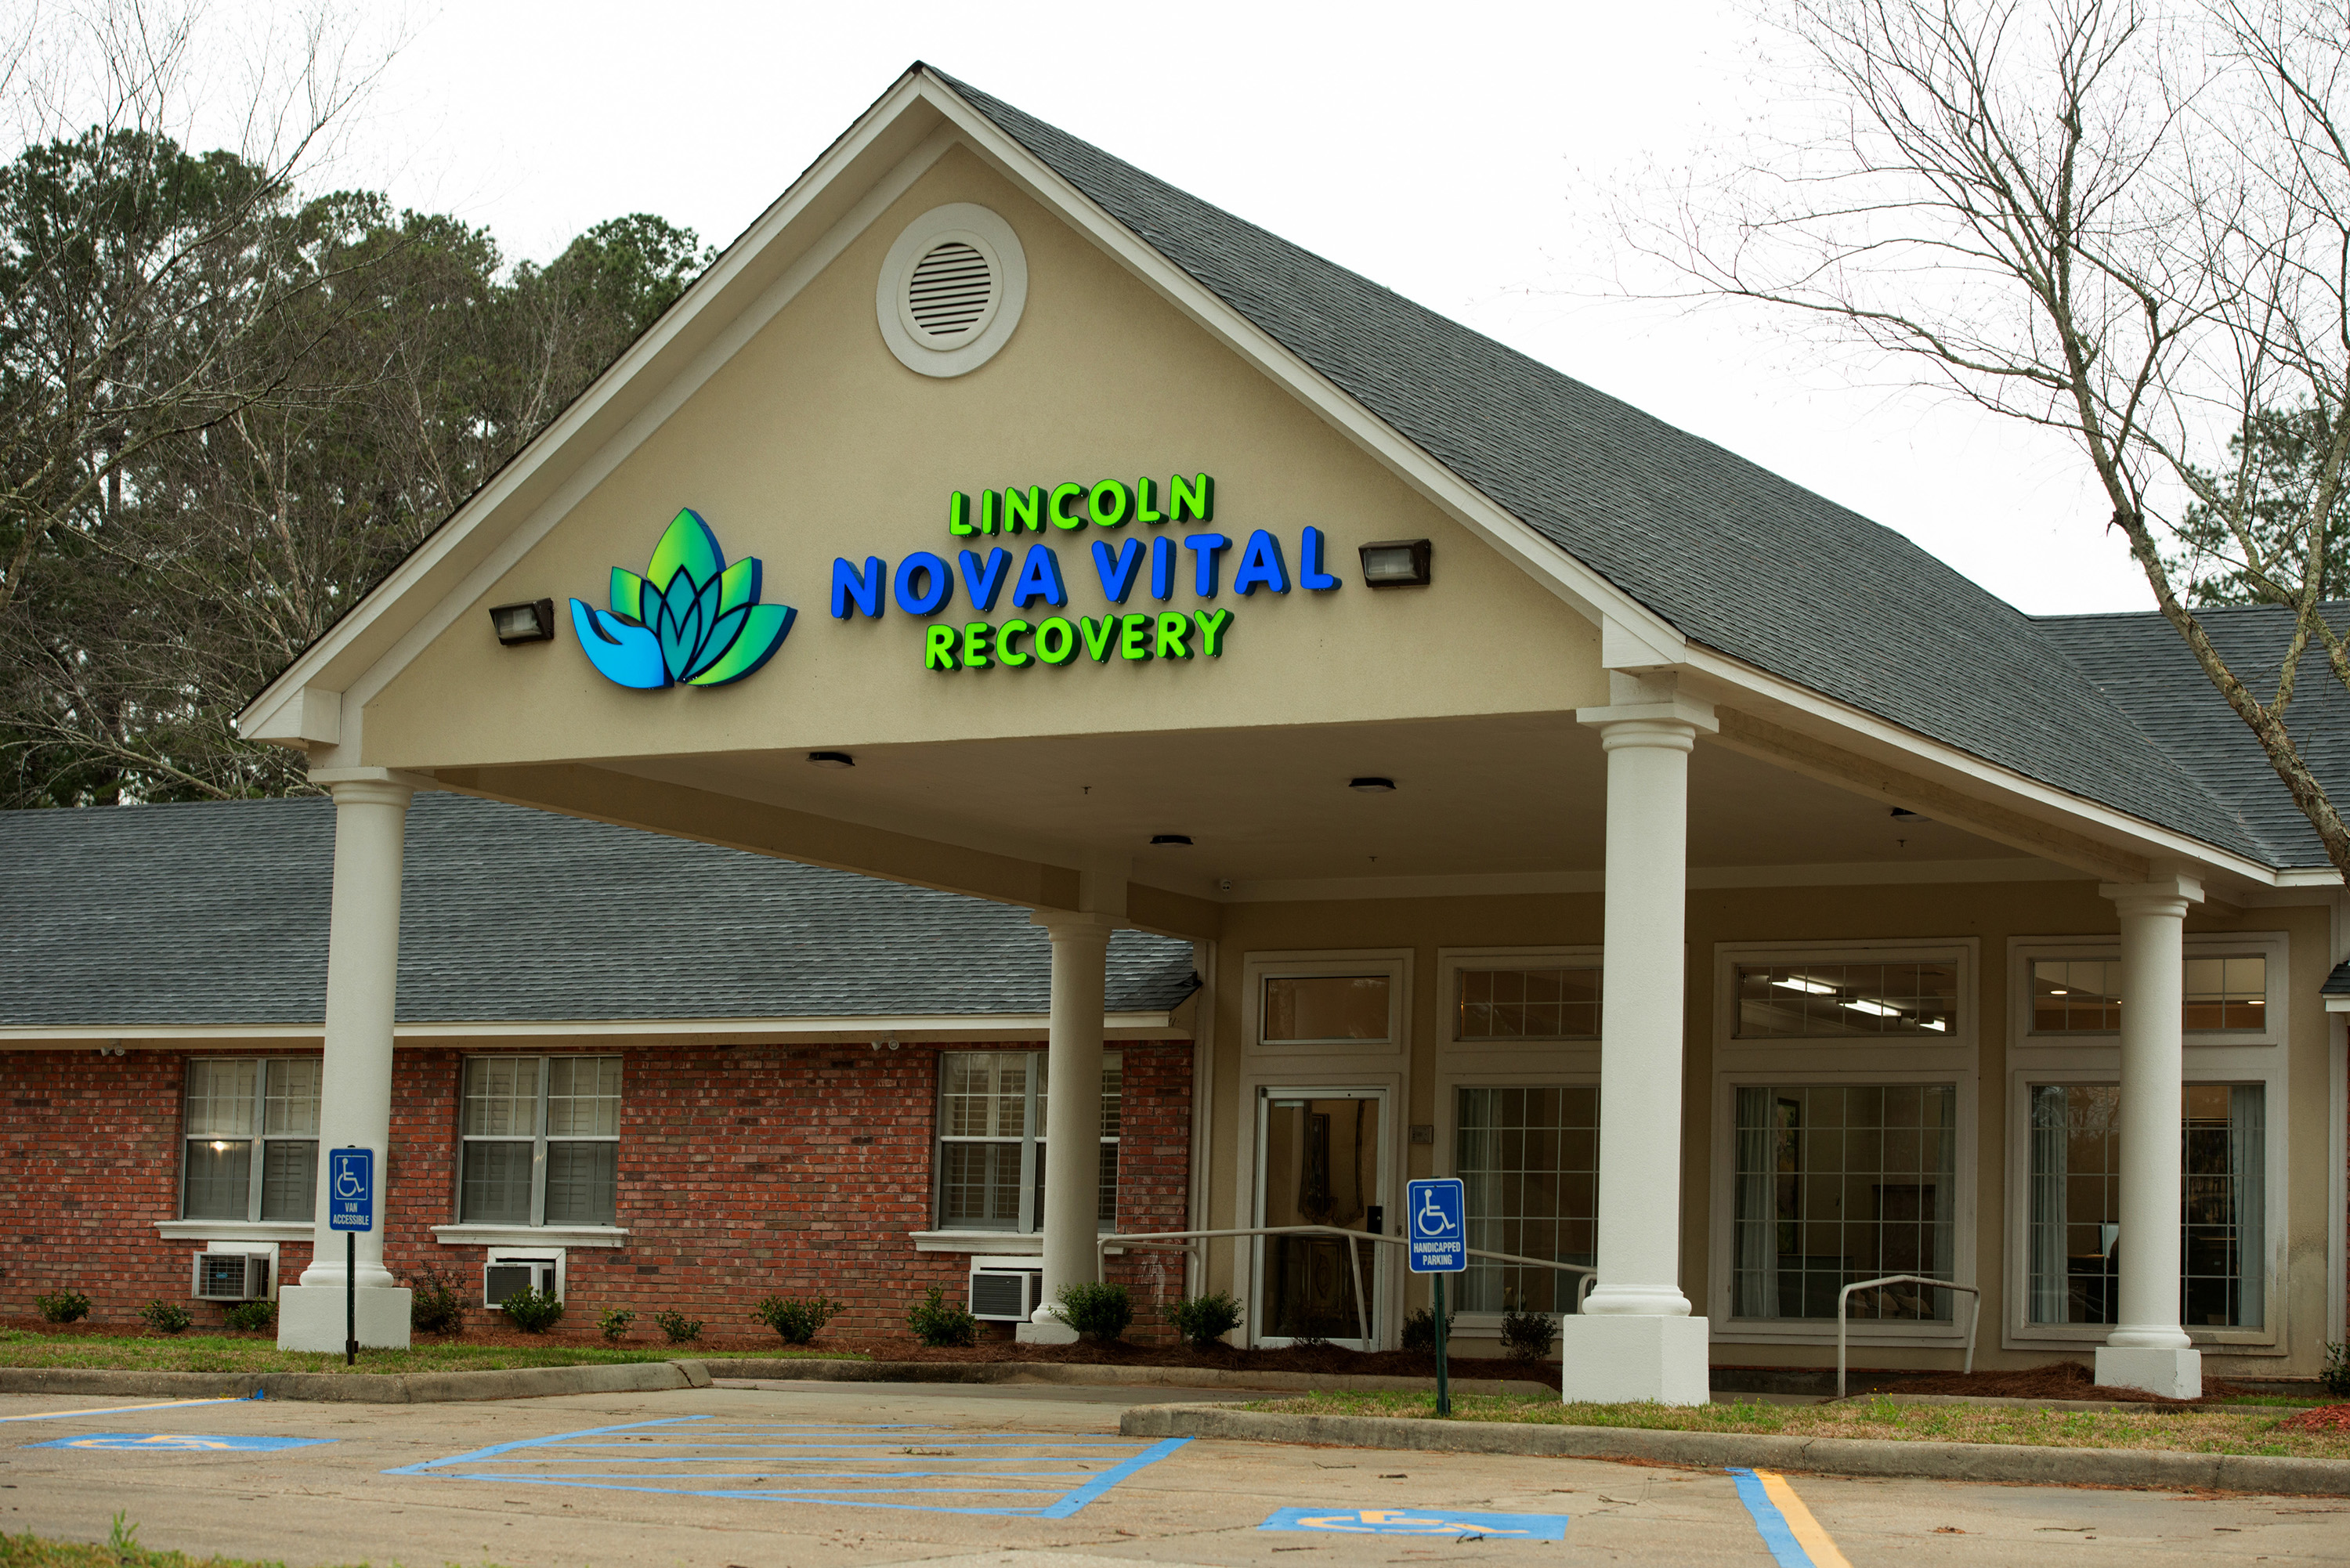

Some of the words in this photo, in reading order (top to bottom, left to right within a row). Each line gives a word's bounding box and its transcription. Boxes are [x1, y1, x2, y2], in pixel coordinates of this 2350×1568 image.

[949, 472, 1211, 537] LINCOLN
[830, 543, 1064, 619] NOVA
[1090, 526, 1338, 602] VITAL
[924, 608, 1230, 670] RECOVERY
[345, 1202, 358, 1212] VAN
[333, 1214, 369, 1225] ACCESSIBLE
[1413, 1241, 1461, 1253] HANDICAPPED
[1423, 1254, 1453, 1266] PARKING
